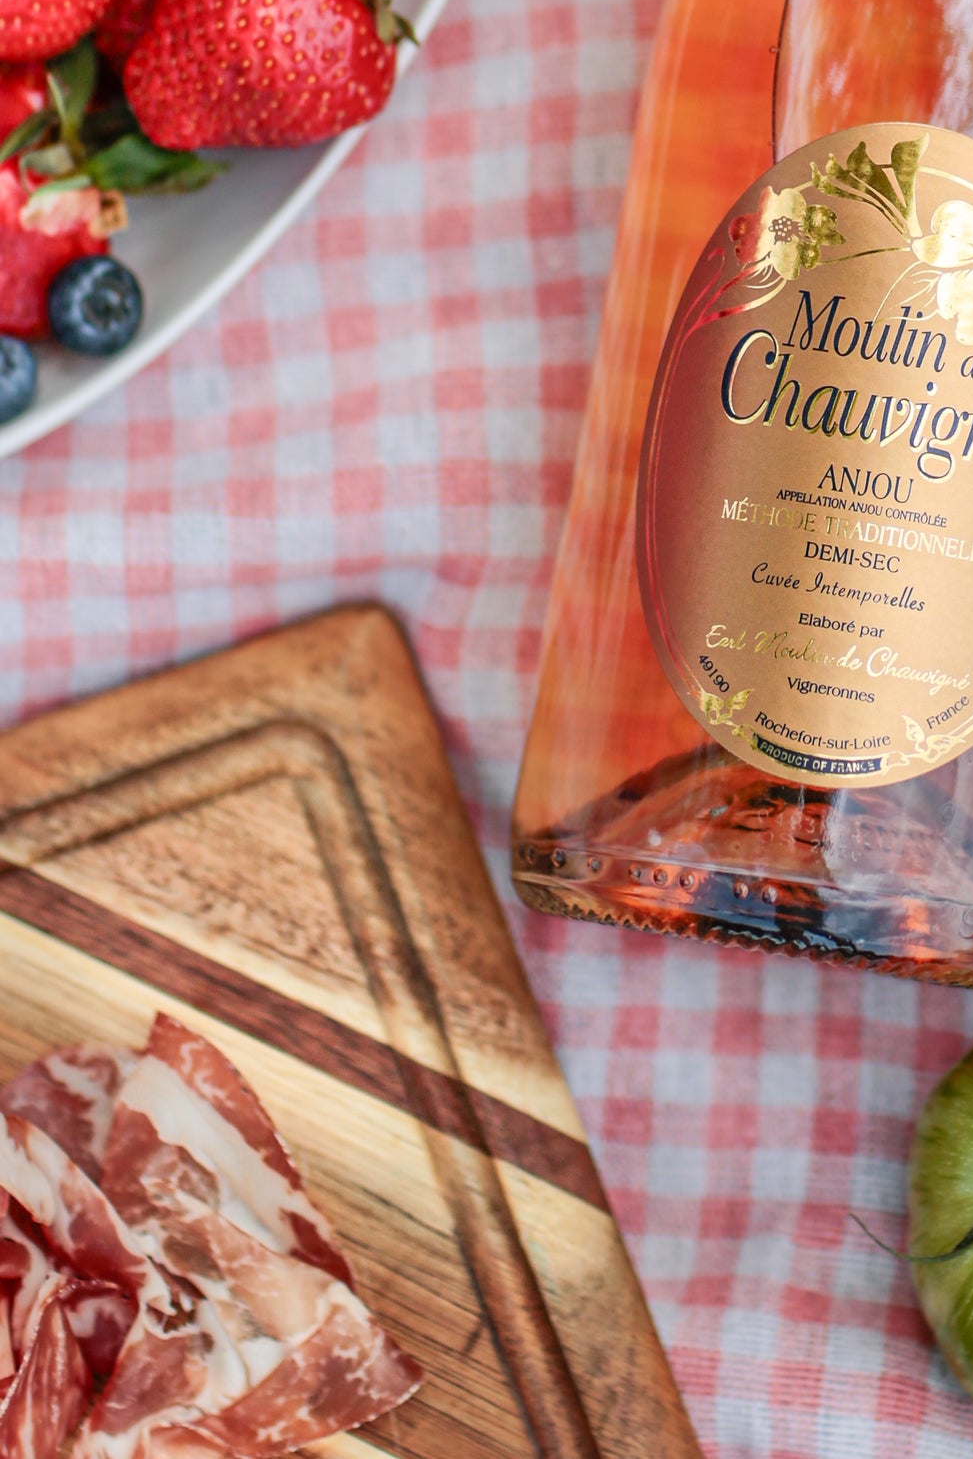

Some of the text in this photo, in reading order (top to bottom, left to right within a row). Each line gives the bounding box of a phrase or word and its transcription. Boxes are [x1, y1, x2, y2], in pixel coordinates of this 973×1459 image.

[782, 290, 949, 373] Moulin
[817, 463, 914, 504] ANJOU
[721, 497, 817, 533] MÉTHODE
[776, 489, 948, 529] APPELLATION ANJOU CONTRÔLÉE
[803, 541, 901, 574] DEMI-SEC
[751, 562, 926, 613] Cuvée Intemporelles
[798, 613, 885, 639] Elaboré par
[698, 654, 730, 693] 49190
[787, 676, 876, 704] Vigneronnes
[836, 645, 862, 671] de
[866, 646, 971, 696] Chauvigné
[755, 711, 891, 750] Rochefort-sur-Loire
[926, 694, 971, 730] France
[760, 741, 875, 774] PRODUCT OF FRANCE
